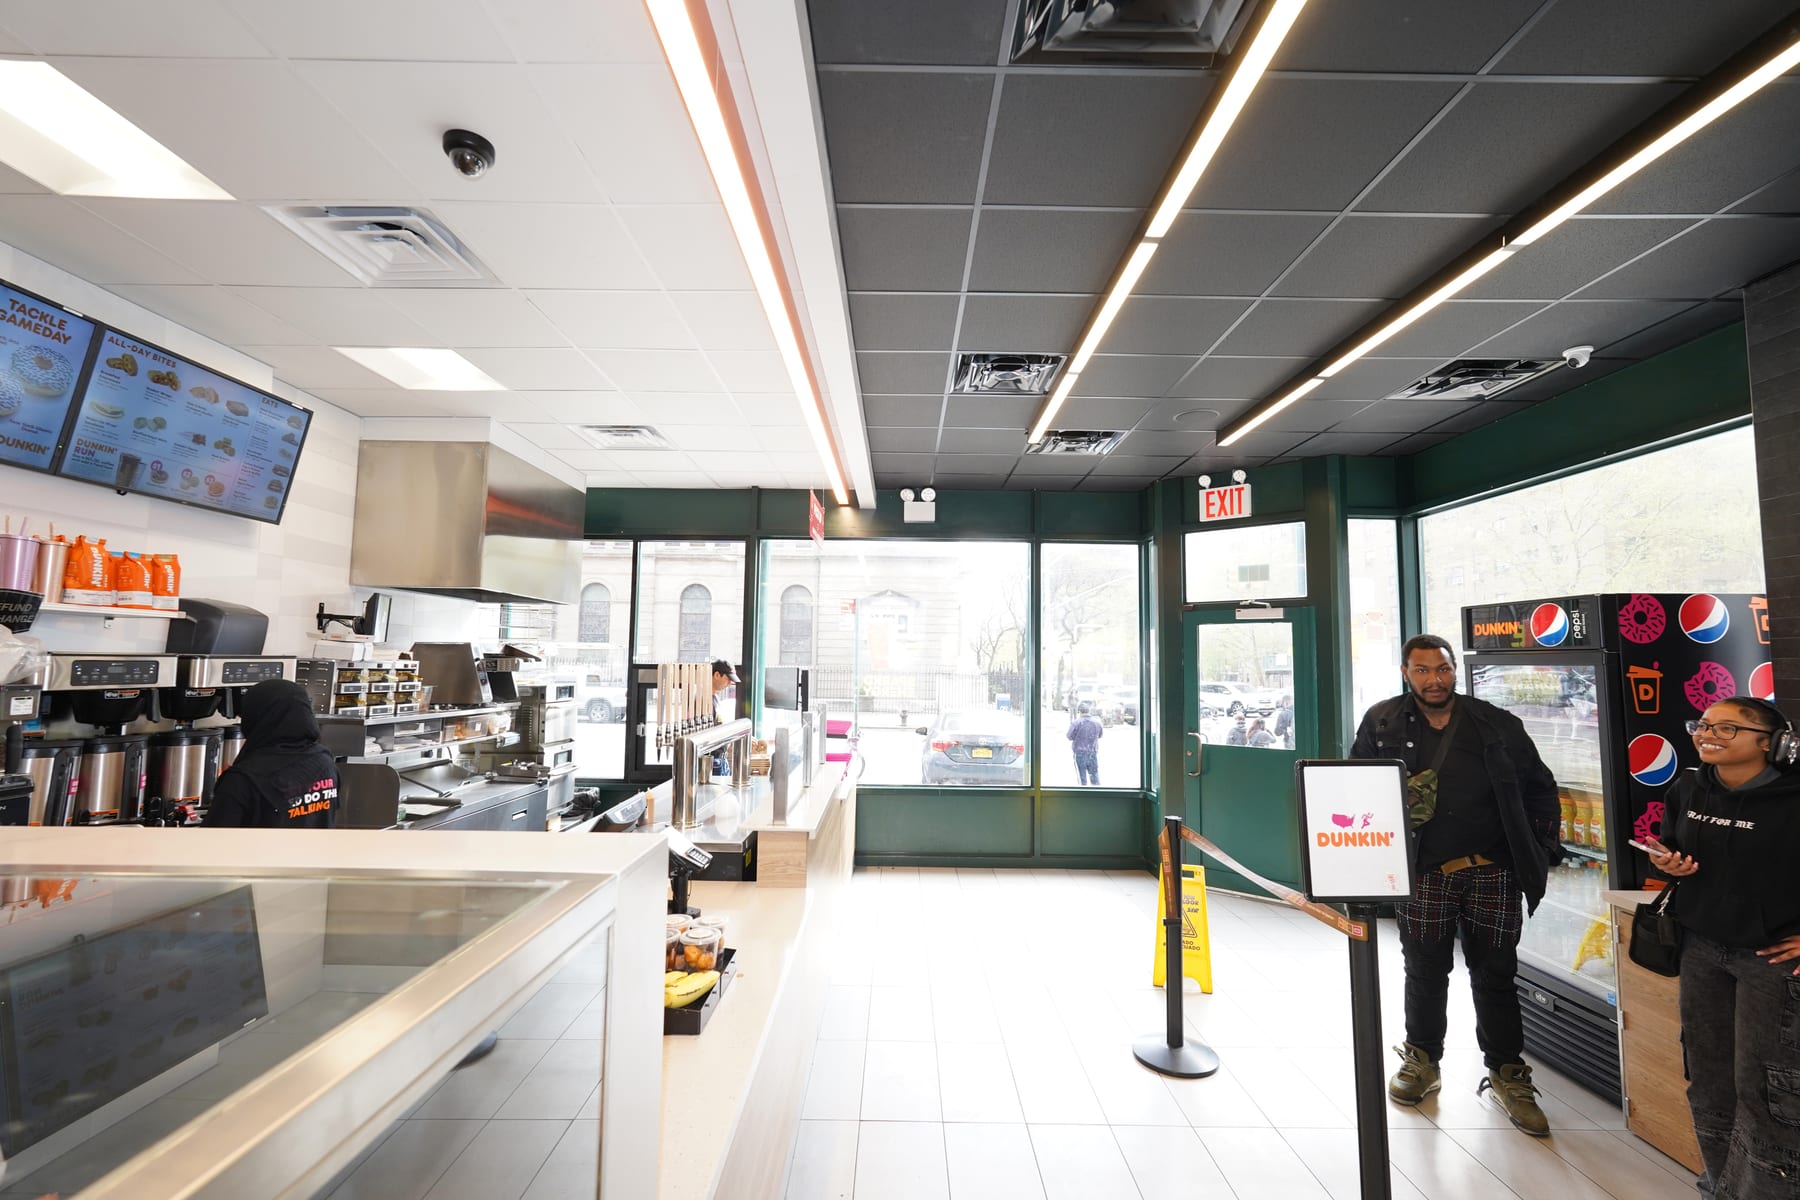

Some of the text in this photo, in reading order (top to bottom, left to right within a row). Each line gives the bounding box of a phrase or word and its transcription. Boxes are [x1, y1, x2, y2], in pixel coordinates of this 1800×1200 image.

[9, 298, 69, 331] TACKLE
[0, 309, 72, 345] GAMEDAY
[107, 336, 177, 368] ALL-DAY BITES
[74, 446, 96, 457] RUN
[76, 438, 118, 454] DUNKIN'
[1205, 486, 1245, 518] EXIT
[0, 602, 33, 612] FUND
[0, 614, 34, 623] HANGE
[1570, 609, 1584, 639] pepsi
[1473, 621, 1520, 636] DUNKIN'
[1638, 684, 1654, 700] D
[308, 778, 334, 792] OUR
[304, 792, 320, 804] DO
[288, 800, 331, 819] TALKING
[1709, 816, 1732, 826] FOR
[1734, 820, 1756, 830] ME
[1316, 831, 1395, 847] DUNKIN'
